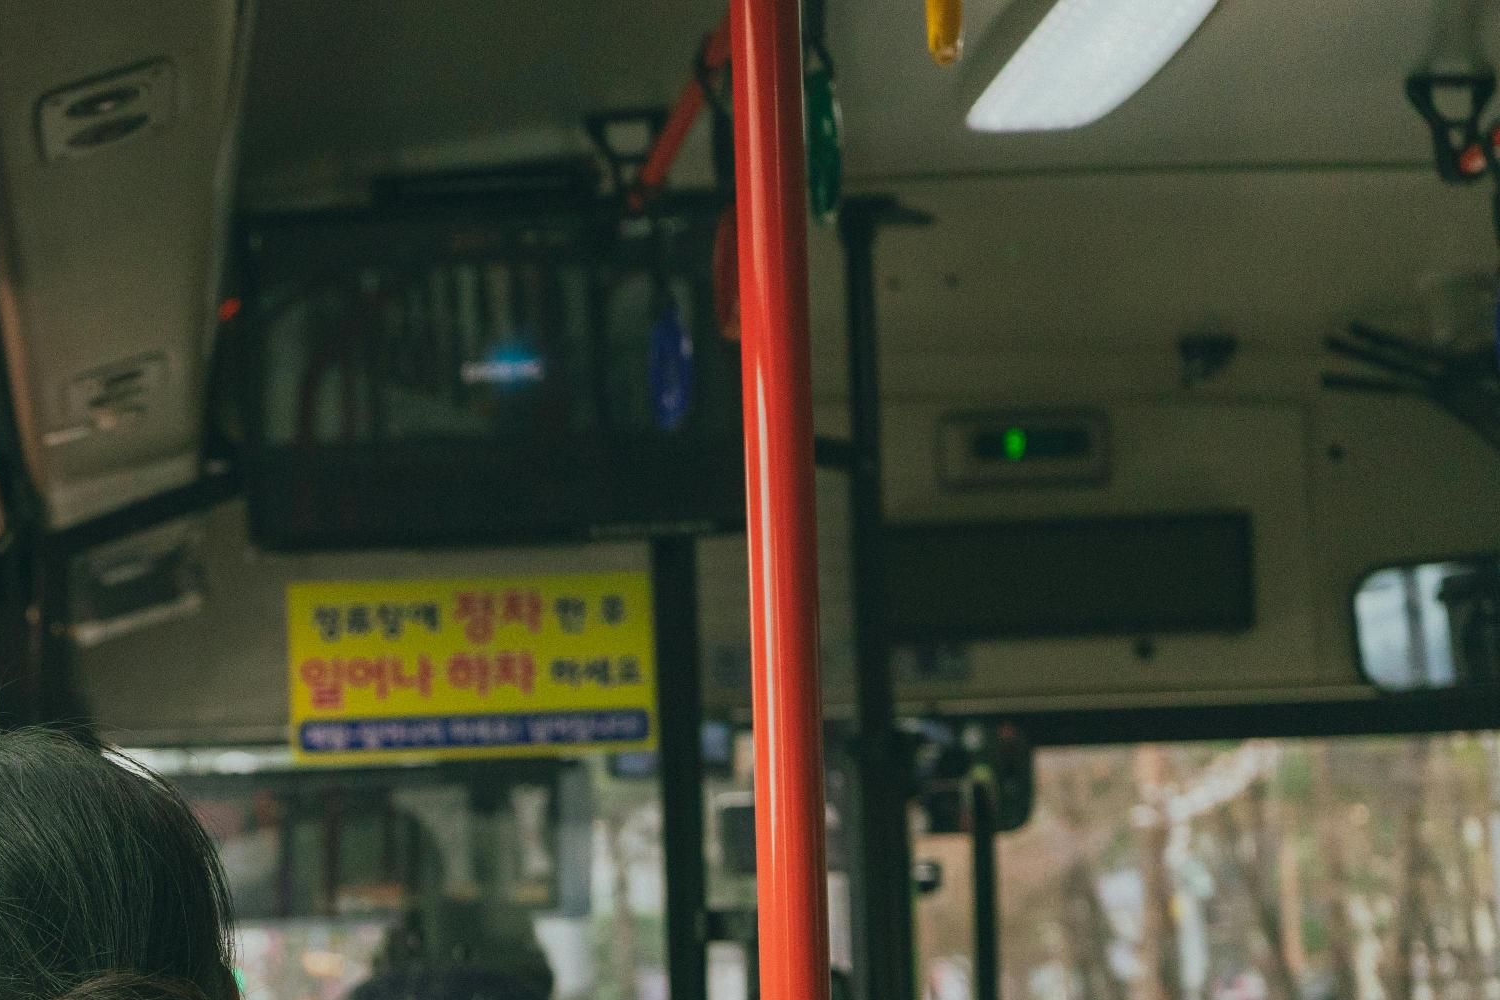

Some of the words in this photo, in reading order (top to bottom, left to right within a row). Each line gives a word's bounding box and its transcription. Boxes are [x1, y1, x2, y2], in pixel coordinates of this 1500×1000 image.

[453, 589, 543, 645] 정차
[300, 653, 433, 709] 일어나
[447, 651, 535, 696] 하차
